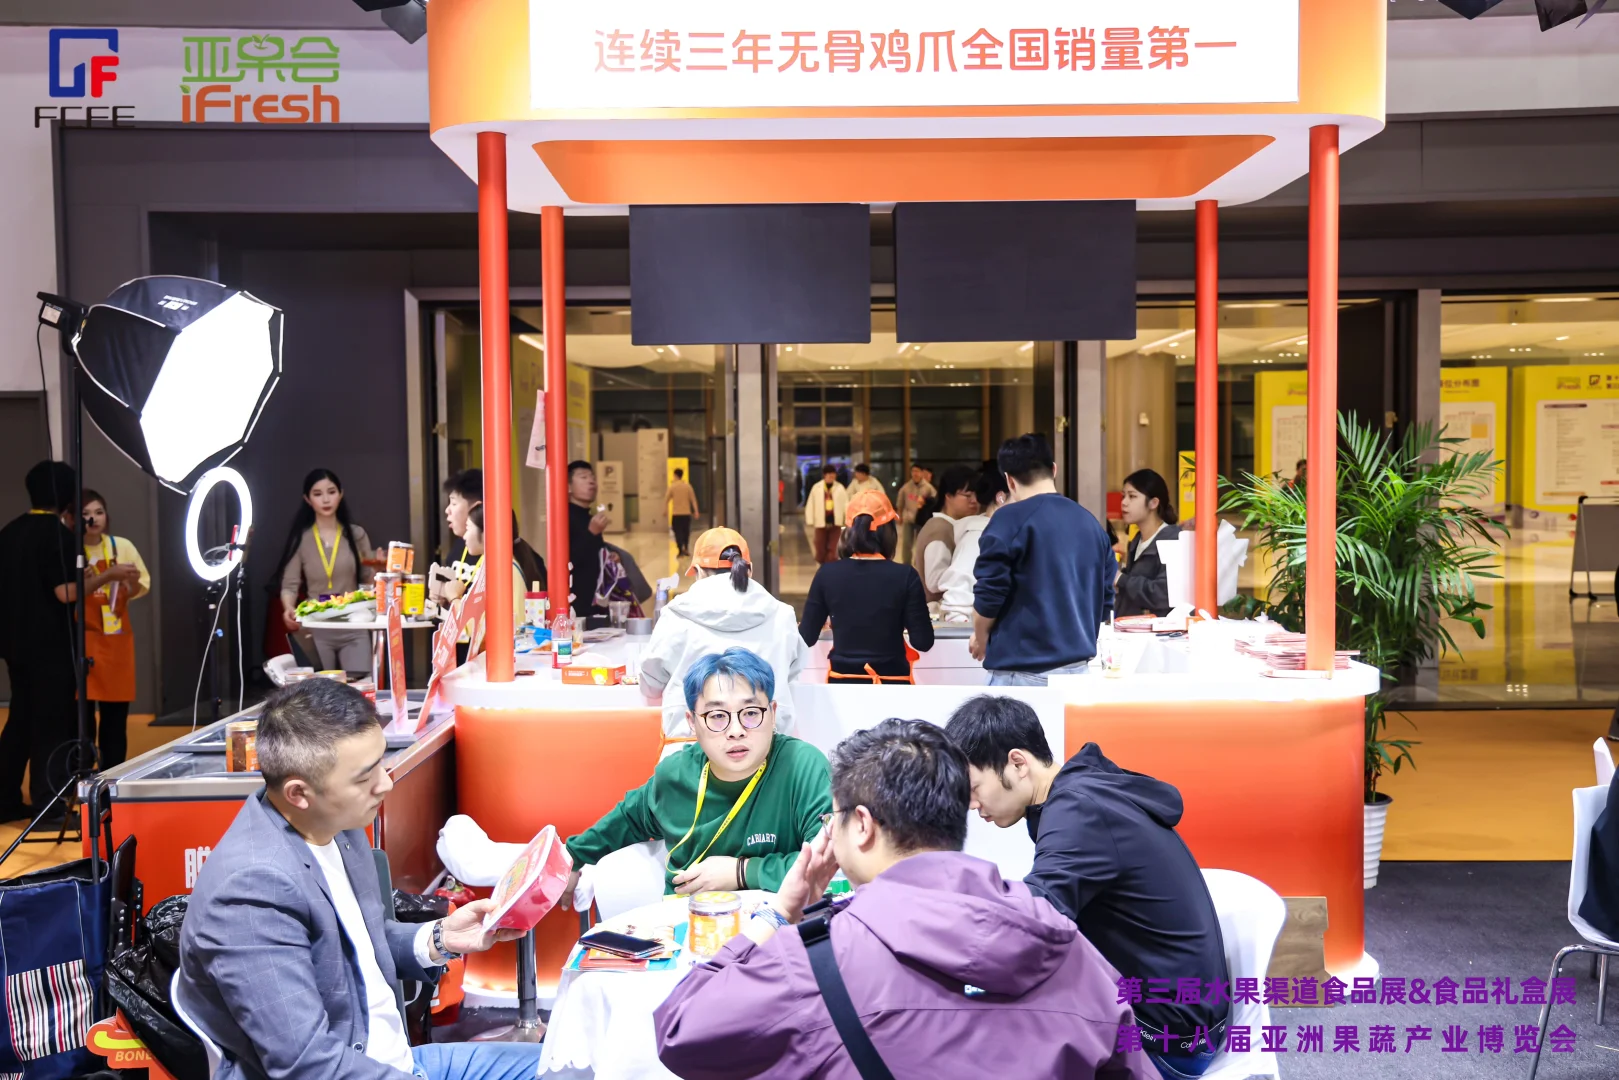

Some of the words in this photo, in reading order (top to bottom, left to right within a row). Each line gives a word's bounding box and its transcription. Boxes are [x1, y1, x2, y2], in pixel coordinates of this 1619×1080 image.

[594, 25, 1237, 73] 连续三年无骨鸡爪全国销量第一
